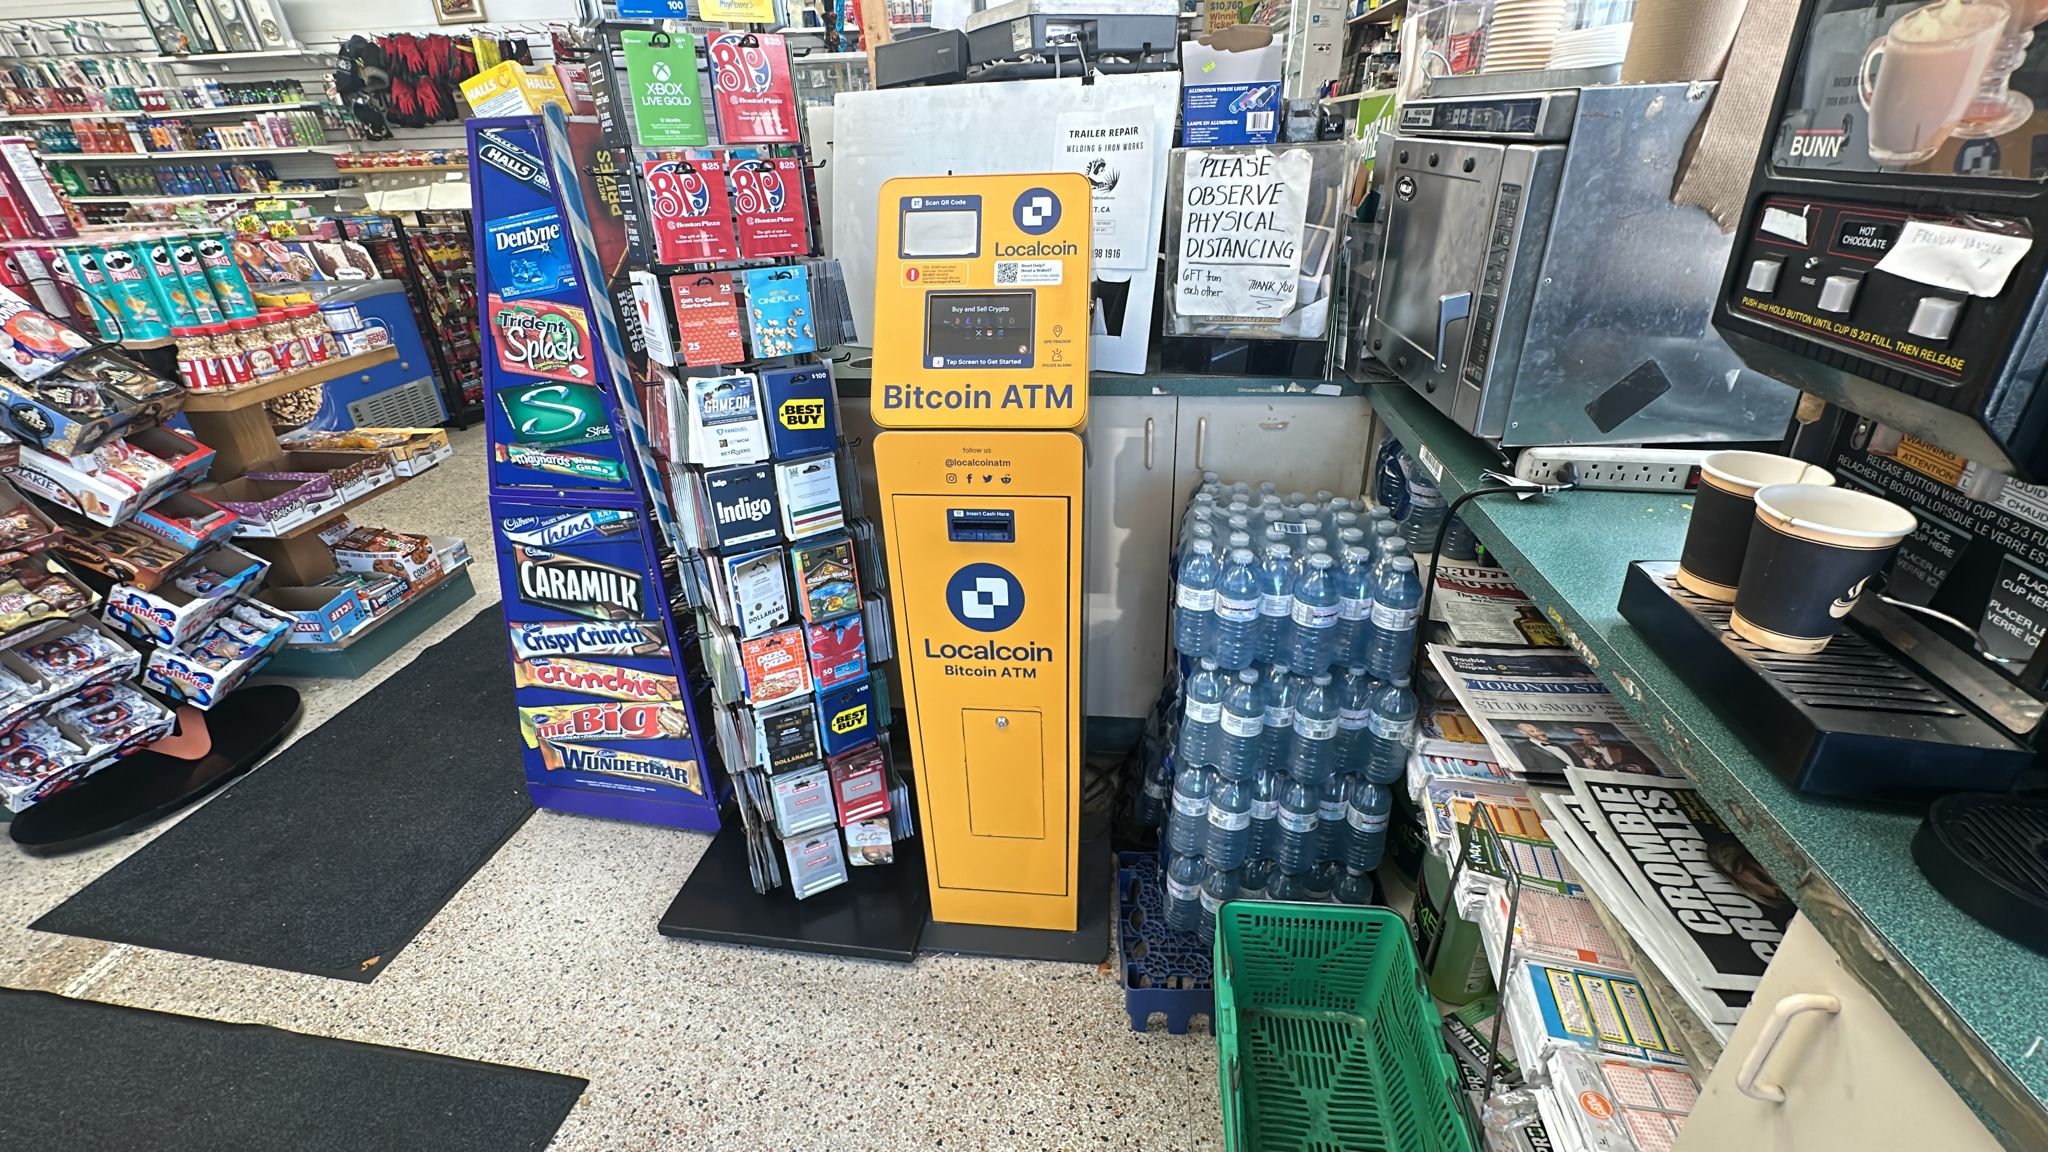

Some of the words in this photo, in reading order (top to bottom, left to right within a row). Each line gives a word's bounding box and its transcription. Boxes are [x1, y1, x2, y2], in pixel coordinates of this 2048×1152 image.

[668, 1, 683, 10] 100
[1210, 1, 1243, 10] $10,760
[466, 80, 498, 102] HALLS
[526, 78, 556, 93] HALLS
[646, 82, 685, 96] XBOX
[642, 96, 665, 106] LIVE
[666, 96, 692, 106] GOLD
[486, 130, 521, 153] HALLS
[1068, 128, 1106, 139] TRAILER
[1108, 126, 1140, 137] REPAIR
[1066, 144, 1096, 153] WELDING
[1104, 143, 1121, 152] IRON
[1122, 141, 1144, 150] WORKS
[1790, 135, 1842, 158] BUNN
[486, 147, 532, 178] HALLS
[701, 162, 720, 170] $25
[779, 161, 796, 169] $25
[1200, 155, 1272, 178] PLEASE
[597, 149, 622, 218] PRIZES
[1188, 181, 1286, 206] OBSERVE
[676, 220, 700, 228] Boston
[1187, 210, 1286, 234] PHYSICAL
[496, 222, 560, 250] Dentyne
[1858, 226, 1876, 237] HOT
[995, 240, 1078, 257] Localcoin
[1186, 237, 1294, 260] DISTANCING
[1842, 236, 1887, 250] CHOCOLATE
[1104, 248, 1121, 259] 1916
[110, 270, 144, 284] PRINGLES
[1248, 279, 1276, 292] THANK
[1278, 278, 1295, 294] YOU
[1800, 275, 1816, 287] RINSE
[719, 284, 731, 292] 25
[757, 294, 800, 306] CINEPLEX
[498, 312, 566, 334] Trident
[616, 290, 640, 353] SLUSH
[1742, 295, 1757, 309] PUSH
[1757, 301, 1769, 312] and
[1769, 303, 1786, 318] HOLD
[1786, 308, 1813, 327] BUTTON
[1813, 316, 1832, 332] UNTIL
[1834, 321, 1850, 336] CUP
[1850, 327, 1858, 338] IS
[1858, 328, 1871, 342] 2/3
[1871, 333, 1893, 350] FULL,
[1895, 340, 1921, 357] THEN
[1920, 346, 1965, 371] RELEASE
[504, 326, 584, 371] Splash
[687, 342, 700, 351] 25
[884, 382, 992, 410] Bitcoin
[1000, 384, 1074, 409] ATM
[784, 404, 824, 415] BEST
[786, 414, 820, 425] BUY
[586, 425, 612, 438] Stride
[1904, 434, 1957, 461] WARNING
[944, 458, 1012, 469] @localcoinatm
[1901, 452, 1954, 480] ATTENTION
[712, 479, 728, 488] Indigo
[1836, 454, 1878, 482] RELACHER
[1878, 475, 1890, 488] LE
[1890, 480, 1926, 505] BOUTON
[1926, 496, 1973, 529] LORSQUE
[1974, 520, 1989, 536] LE
[1990, 526, 2026, 556] VERRE
[1866, 454, 1903, 480] RELEASE
[1904, 470, 1941, 496] BUTTON
[1941, 486, 1976, 511] WHEN
[1973, 502, 1996, 521] CUP
[1997, 512, 2010, 528] IS
[2010, 519, 2032, 538] 2/3
[503, 516, 540, 532] Cadbury
[528, 516, 594, 546] Thins
[1921, 522, 1952, 544] PLACE
[525, 546, 554, 559] Cadbury
[1929, 541, 1956, 560] HERE
[1898, 547, 1934, 572] PLACER
[1933, 564, 1947, 578] LE
[1896, 559, 1925, 580] VERRE
[1926, 574, 1940, 588] ICI
[520, 560, 638, 612] CARAMILK
[2002, 579, 2025, 598] CUP
[108, 599, 176, 628] Twinkies
[748, 604, 785, 624] DOLLARAMA
[1989, 599, 2032, 627] PLACER
[2032, 621, 2046, 638] LE
[1987, 611, 2023, 639] VERRE
[2023, 632, 2040, 648] ICI
[757, 649, 786, 667] pizza
[924, 638, 1053, 662] Localcoin
[763, 654, 793, 672] pizza
[1451, 656, 1486, 664] Double
[151, 663, 214, 690] Twinkies
[536, 664, 656, 696] crunchie
[944, 665, 997, 678] Bitcoin
[1001, 667, 1037, 679] ATM
[856, 684, 869, 693] $100
[1472, 679, 1570, 693] TORONTO
[1476, 700, 1538, 711] STUDIO
[536, 722, 573, 738] mr.
[572, 702, 660, 740] Big
[836, 707, 867, 724] BEST
[837, 716, 864, 732] BUY
[560, 748, 688, 785] WUNDERBAR
[774, 750, 815, 766] DOLLARAMA
[1590, 784, 1734, 936] CROMBIE
[1632, 788, 1785, 966] CRUMBLES
